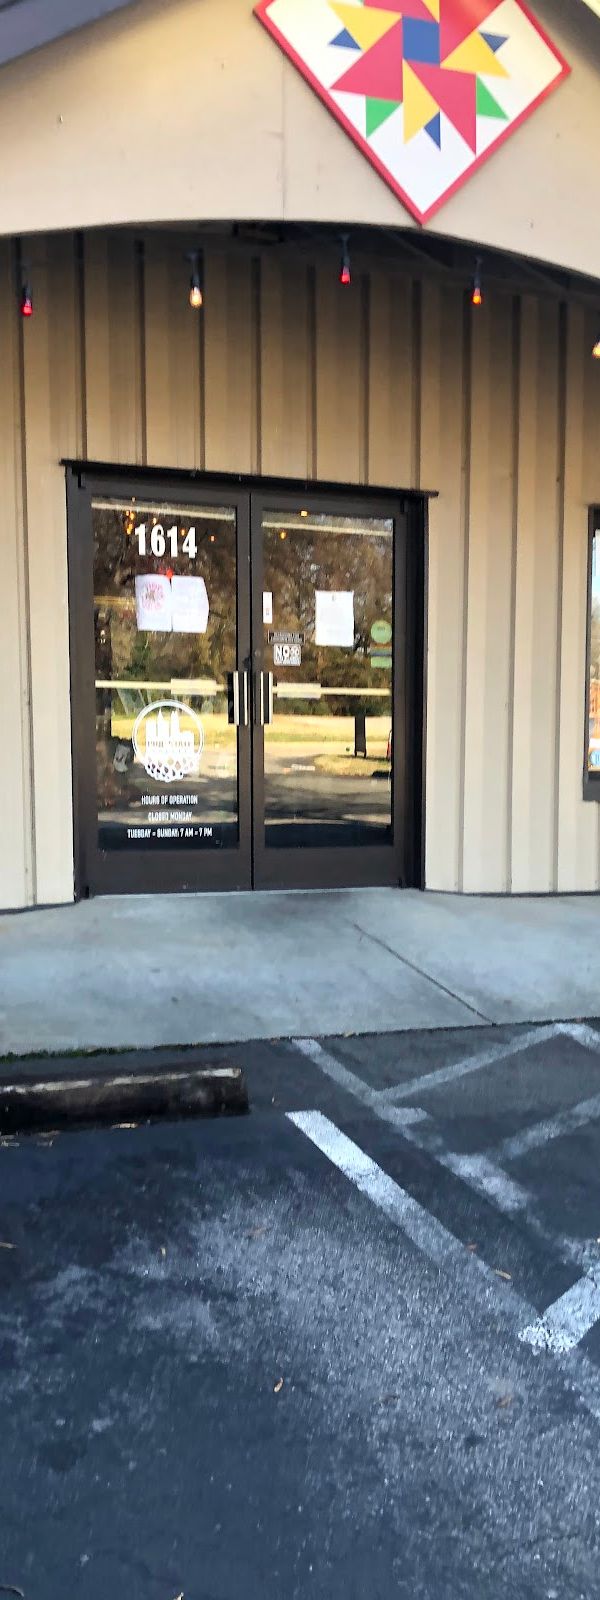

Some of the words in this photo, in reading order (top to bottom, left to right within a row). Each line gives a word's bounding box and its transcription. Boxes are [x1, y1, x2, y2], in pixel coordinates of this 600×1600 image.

[134, 523, 198, 559] 1614
[141, 795, 160, 805] HOURS
[161, 795, 168, 805] OF
[169, 795, 198, 805] OPERATION
[148, 811, 169, 821] CLOSED
[170, 811, 192, 821] MONDAY
[127, 829, 151, 838] TUESDAY
[180, 828, 185, 837] 7
[185, 828, 194, 837] AM
[199, 828, 203, 837] 7
[203, 827, 213, 837] PM
